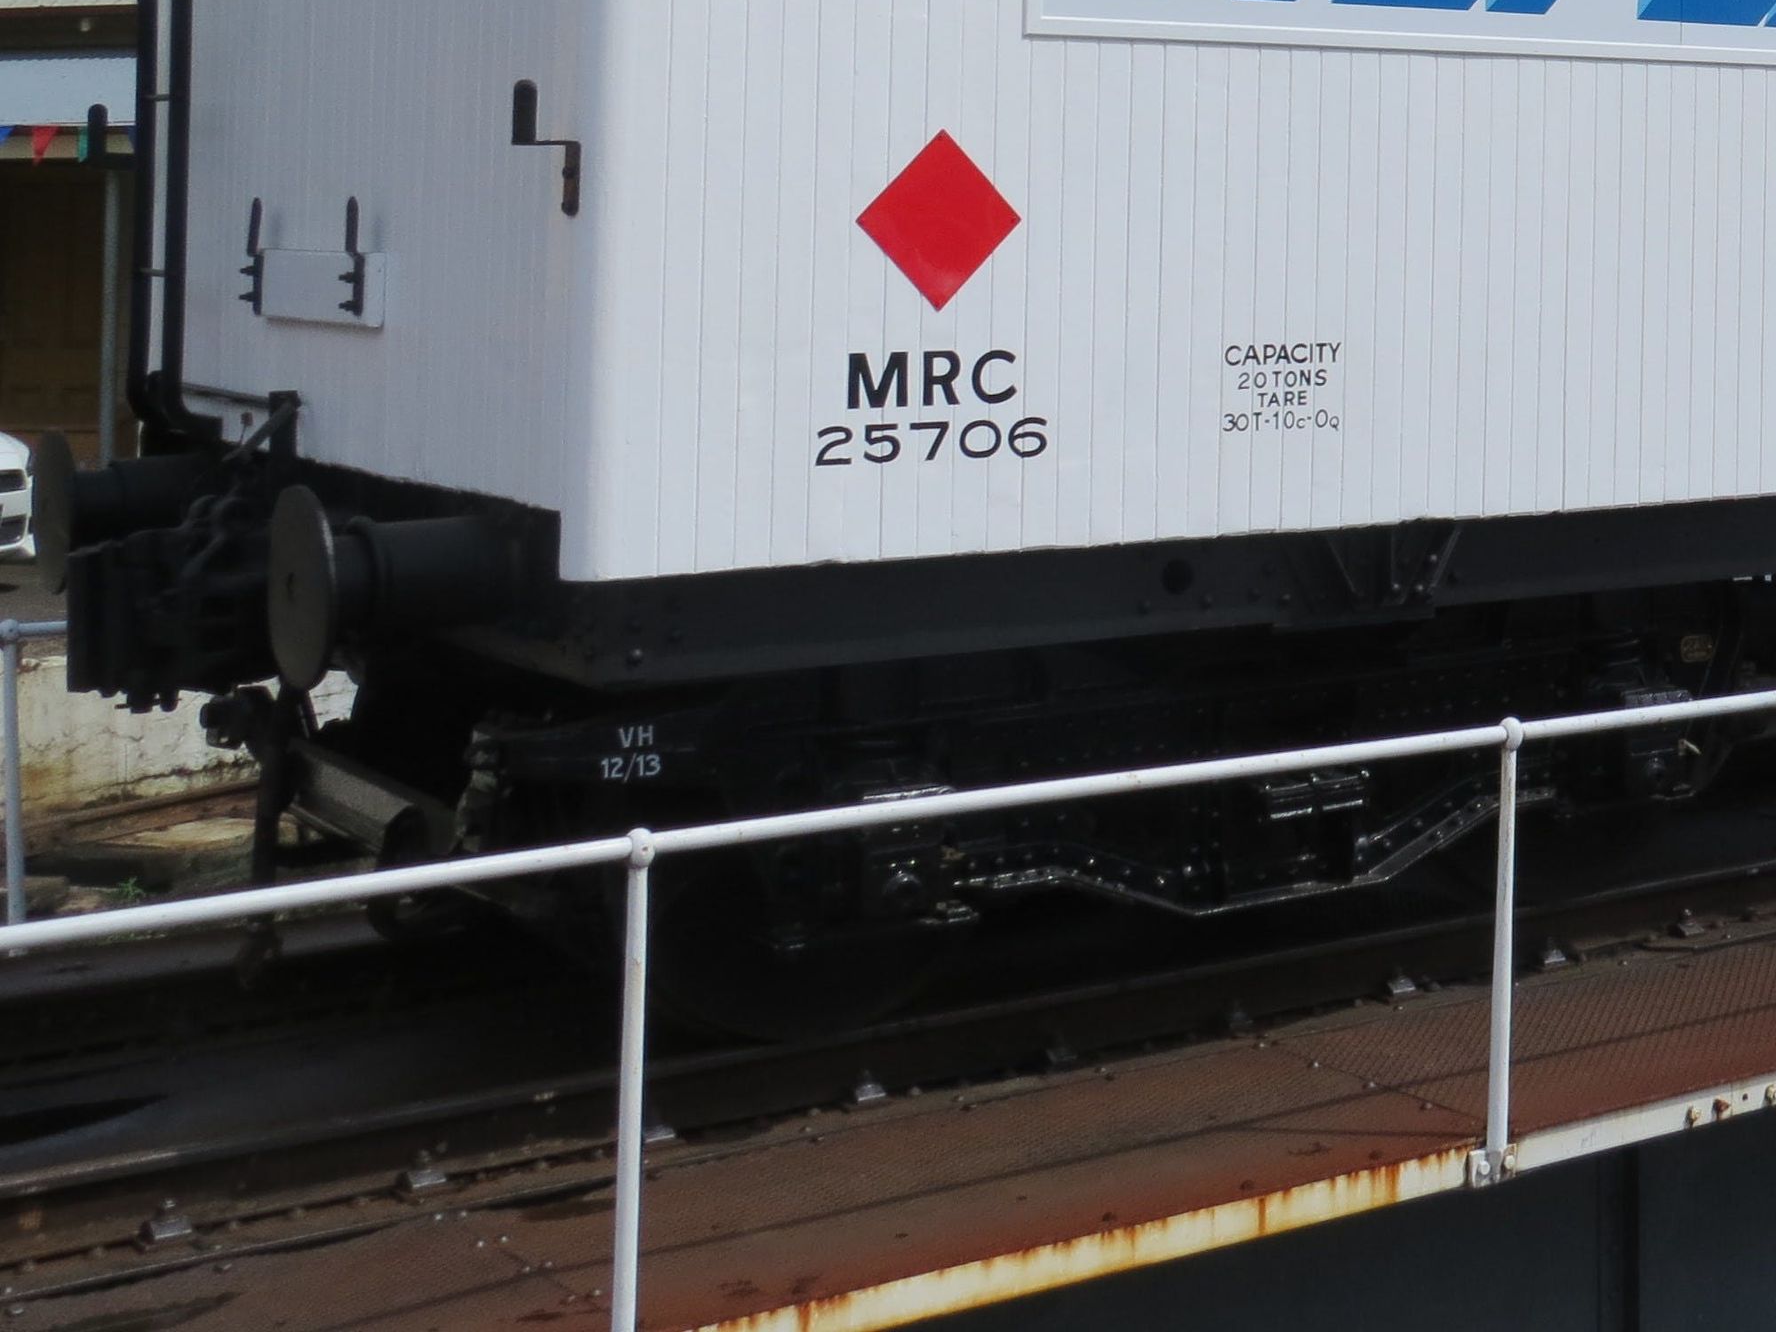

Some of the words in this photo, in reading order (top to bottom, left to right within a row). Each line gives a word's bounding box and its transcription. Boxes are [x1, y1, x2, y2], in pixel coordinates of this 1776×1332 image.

[1223, 341, 1342, 367] CAPACITY
[846, 349, 1018, 410] MRC
[1257, 389, 1308, 408] TARE
[814, 416, 1049, 467] 25706
[617, 725, 655, 749] VH
[600, 752, 662, 784] 12/13
